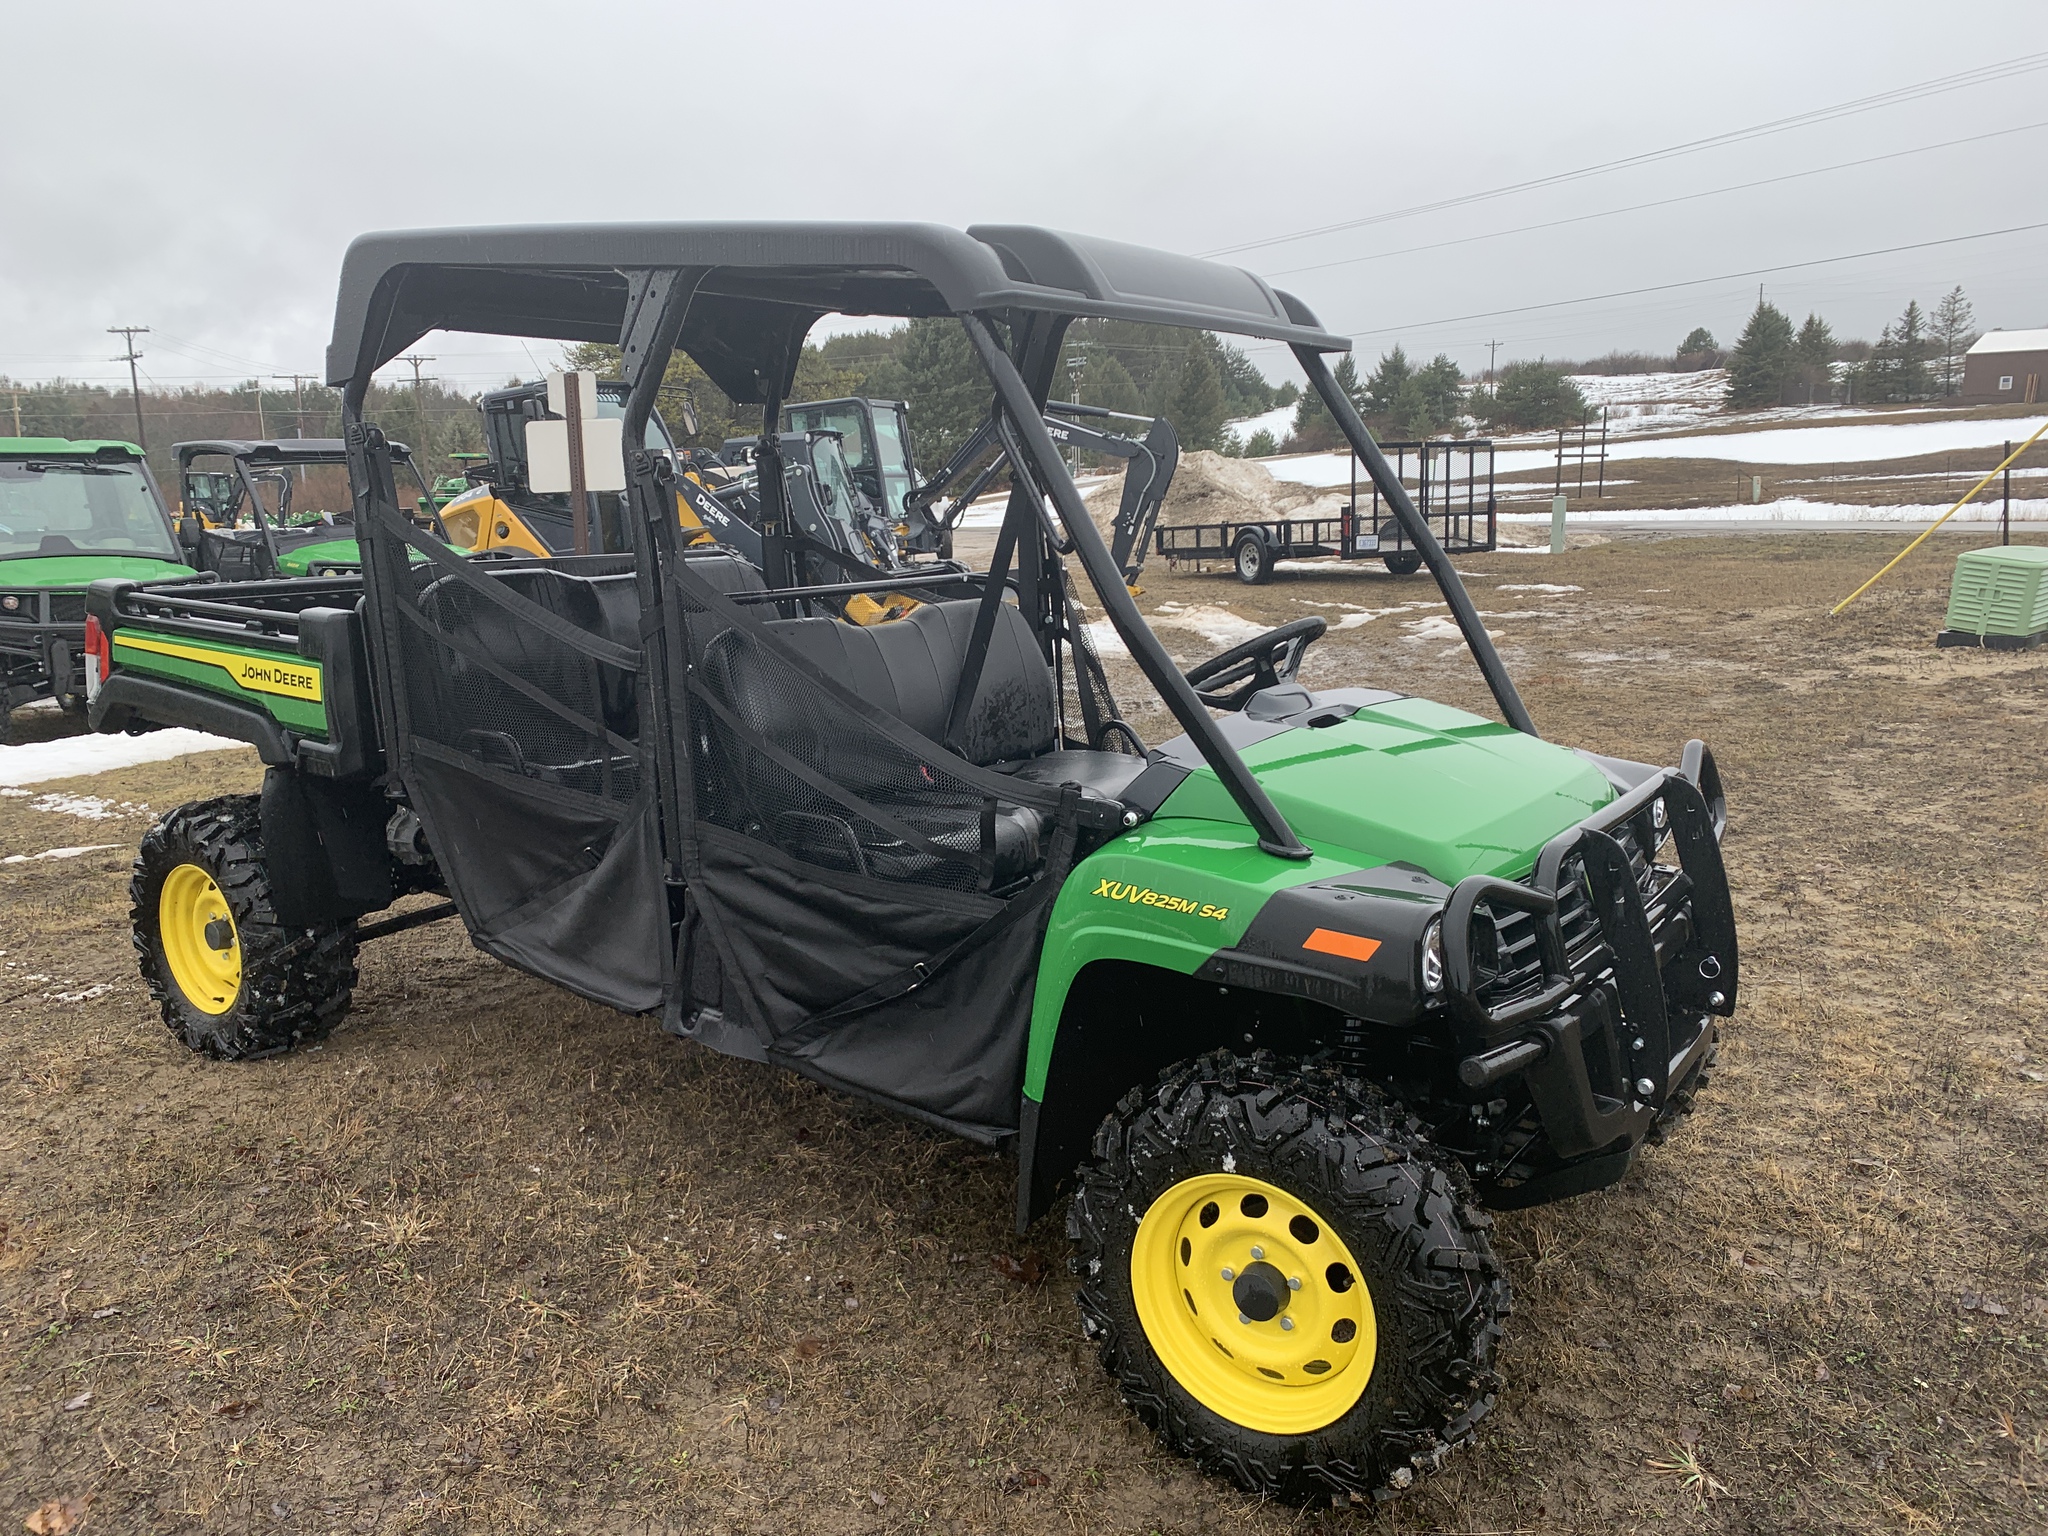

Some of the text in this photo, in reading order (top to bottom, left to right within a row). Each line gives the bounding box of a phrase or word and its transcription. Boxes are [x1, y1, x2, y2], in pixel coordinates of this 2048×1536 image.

[1046, 426, 1070, 440] ERE
[695, 493, 731, 527] DEERE
[241, 663, 313, 690] JOHN DEERE
[1091, 878, 1230, 920] XUV825M S4
